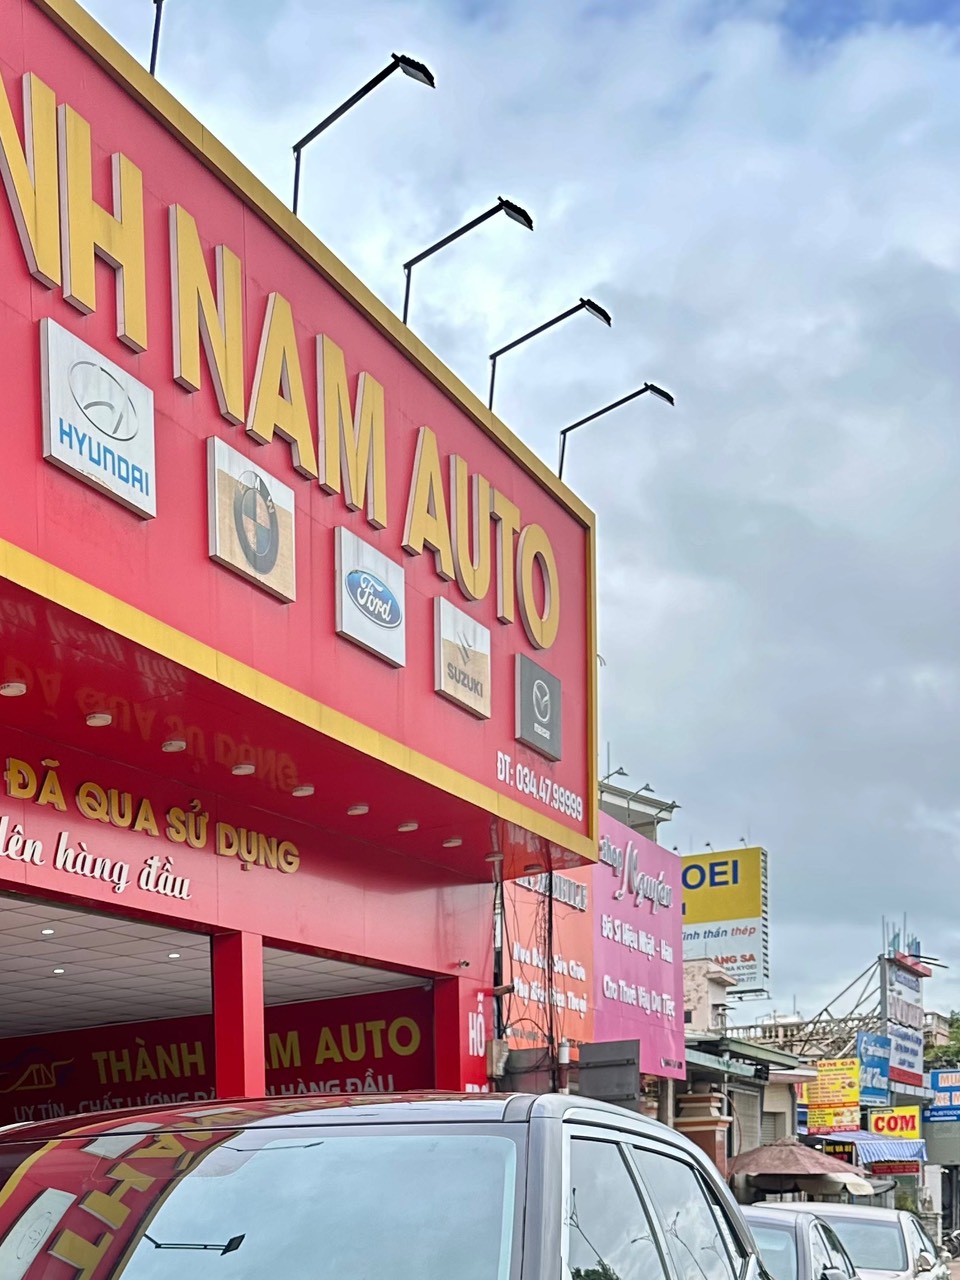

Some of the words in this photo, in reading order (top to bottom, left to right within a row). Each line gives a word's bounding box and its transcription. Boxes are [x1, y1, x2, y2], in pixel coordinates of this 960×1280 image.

[168, 204, 387, 530] NAM
[401, 426, 561, 650] AUTO
[59, 416, 149, 497] HYUNDAI
[357, 574, 392, 621] Ford
[447, 662, 483, 698] SUZUKI
[497, 750, 514, 786] ĐT:
[516, 763, 583, 822] 034.47.99999
[4, 758, 68, 812] ĐÃ
[75, 782, 160, 837] QUA
[165, 798, 208, 850] SỬ
[215, 822, 300, 875] DỤNG
[55, 830, 131, 893] hàng
[138, 856, 192, 901] đầu
[682, 859, 739, 890] OEI
[682, 930, 700, 941] inh
[740, 953, 756, 963] SA
[92, 1037, 206, 1085] THÀNH
[315, 1016, 421, 1065] AUTO
